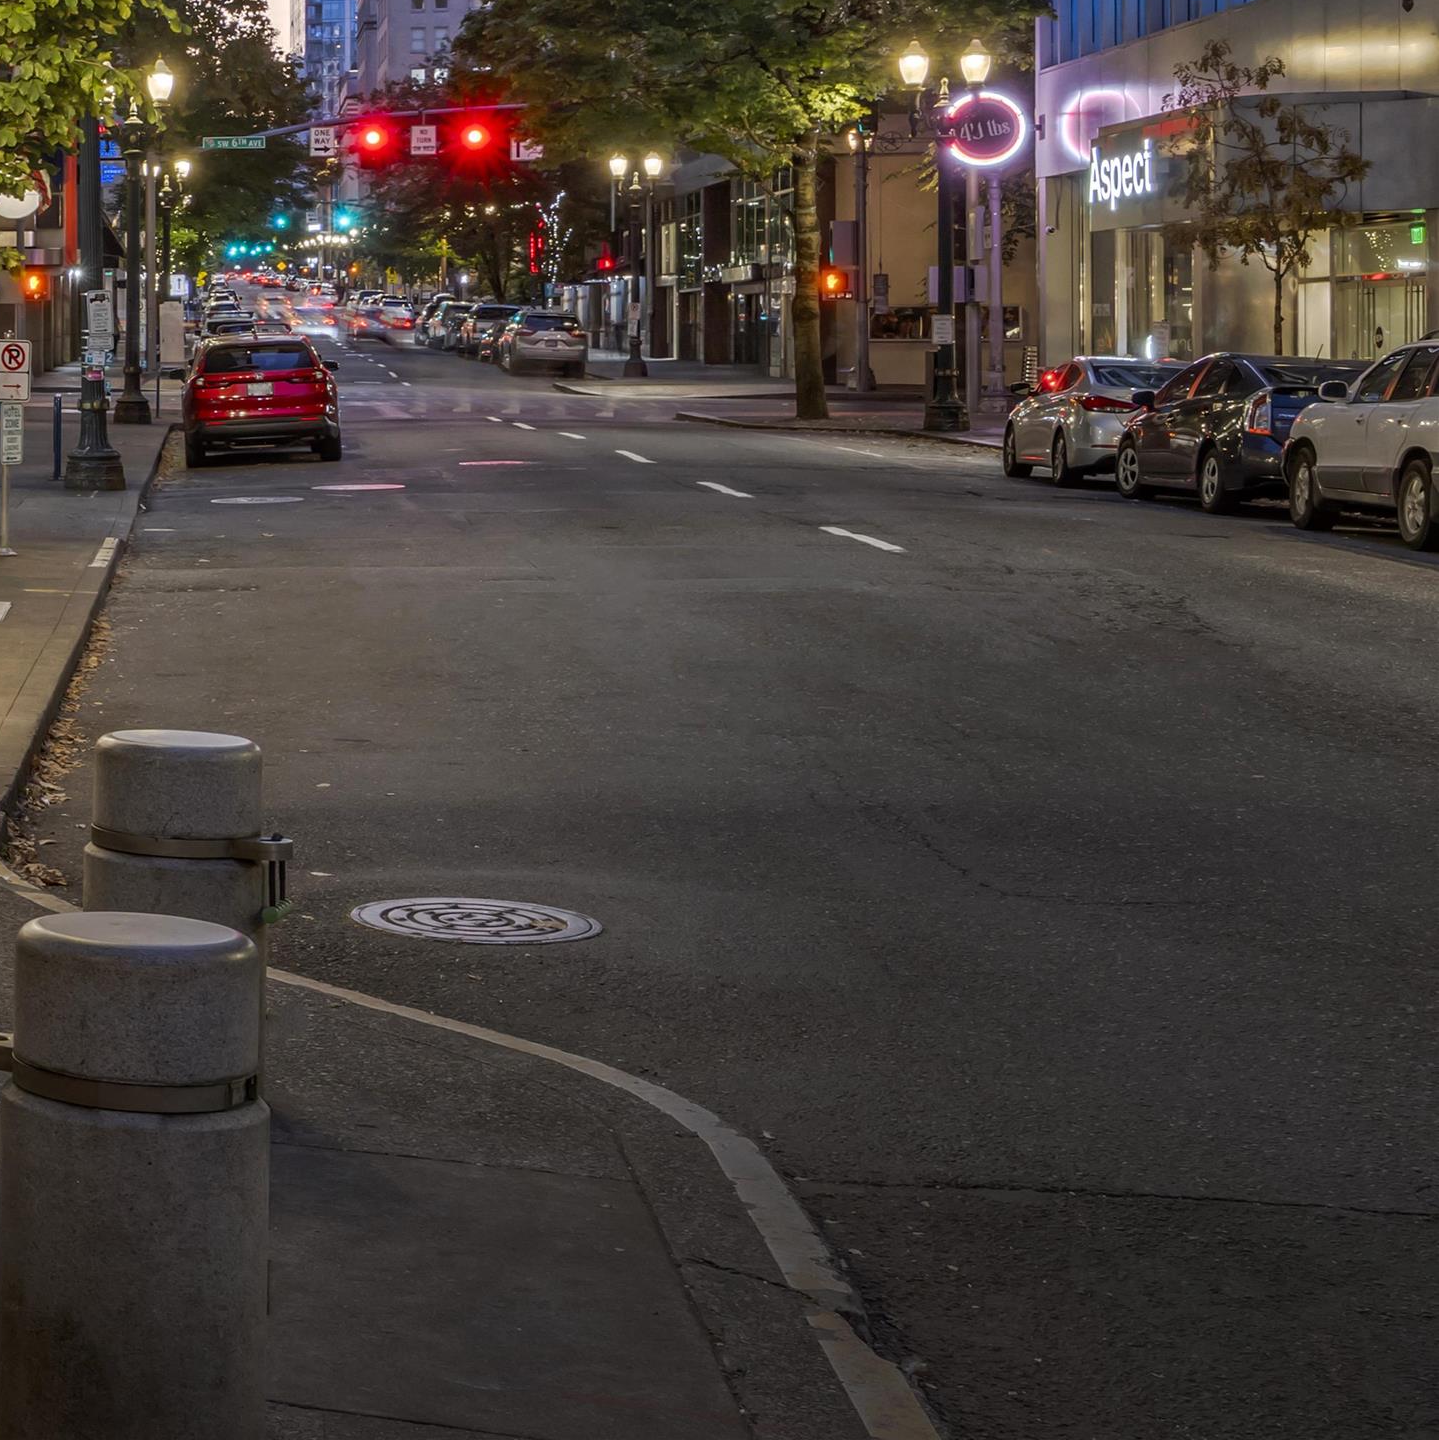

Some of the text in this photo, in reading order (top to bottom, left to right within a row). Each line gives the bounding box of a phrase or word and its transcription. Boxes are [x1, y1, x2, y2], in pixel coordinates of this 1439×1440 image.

[313, 129, 331, 137] ONE
[217, 138, 263, 148] SW 6TH AVE
[313, 137, 331, 146] WAY
[1088, 138, 1152, 212] Aspect
